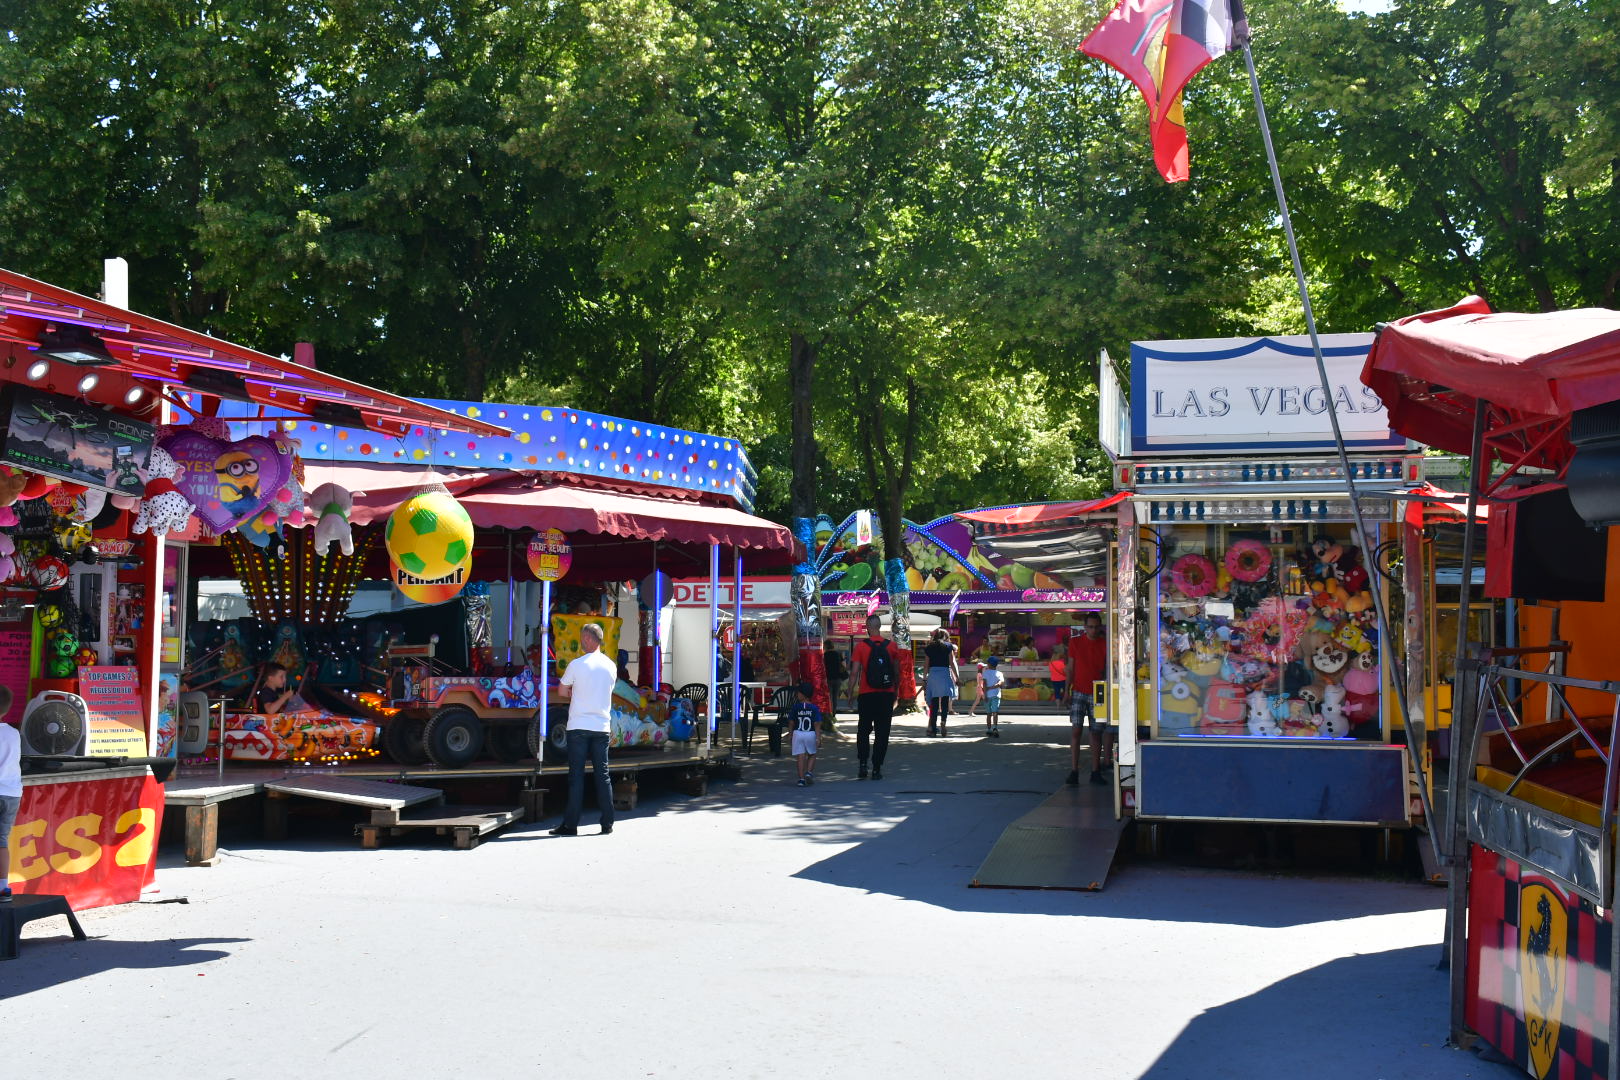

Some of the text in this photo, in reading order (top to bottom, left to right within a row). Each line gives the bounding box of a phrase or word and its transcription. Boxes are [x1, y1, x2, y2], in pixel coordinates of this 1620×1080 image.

[1152, 384, 1383, 418] LAS VEGAS
[108, 419, 151, 441] DRONE
[103, 672, 126, 681] GAMES
[798, 717, 811, 731] 10
